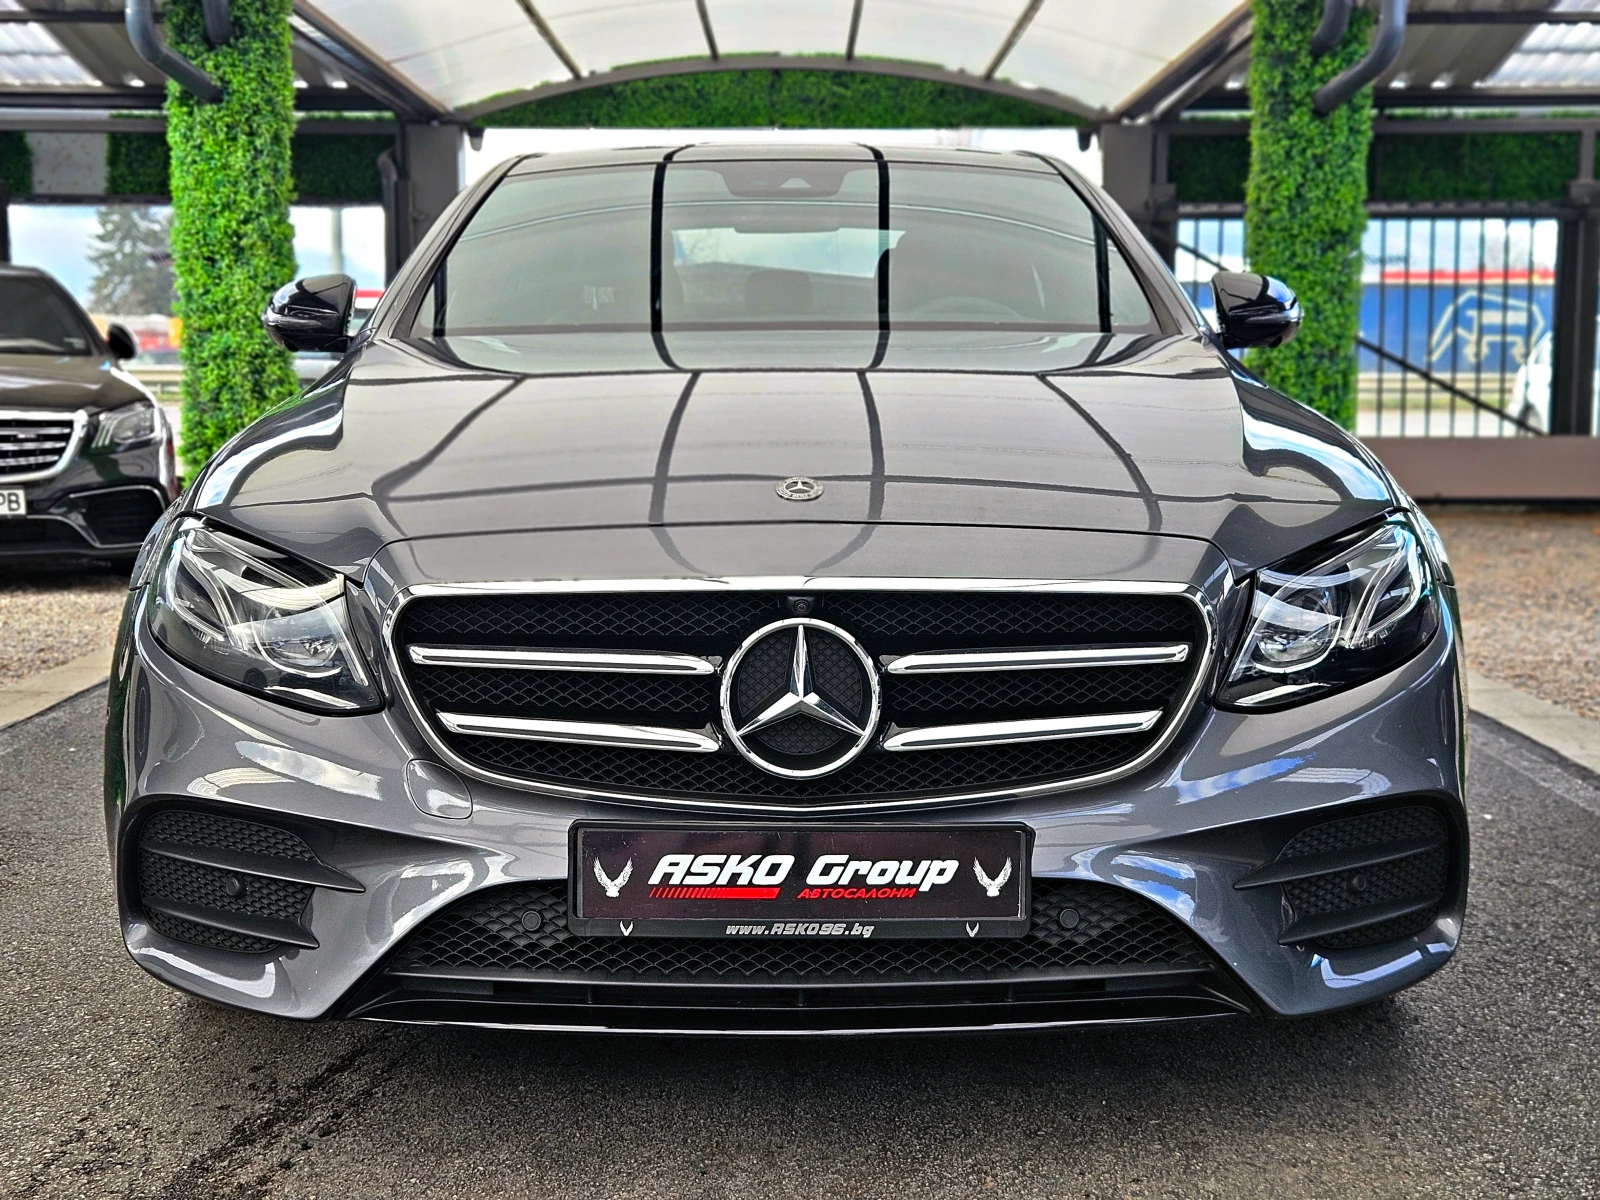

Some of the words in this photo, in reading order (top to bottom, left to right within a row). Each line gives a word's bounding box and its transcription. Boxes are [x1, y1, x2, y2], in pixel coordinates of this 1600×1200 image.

[647, 854, 795, 885] ASKO
[805, 854, 959, 891] Group
[797, 887, 917, 899] АВТОСАЛОНИ
[725, 922, 875, 938] www.ASKO96.bg
